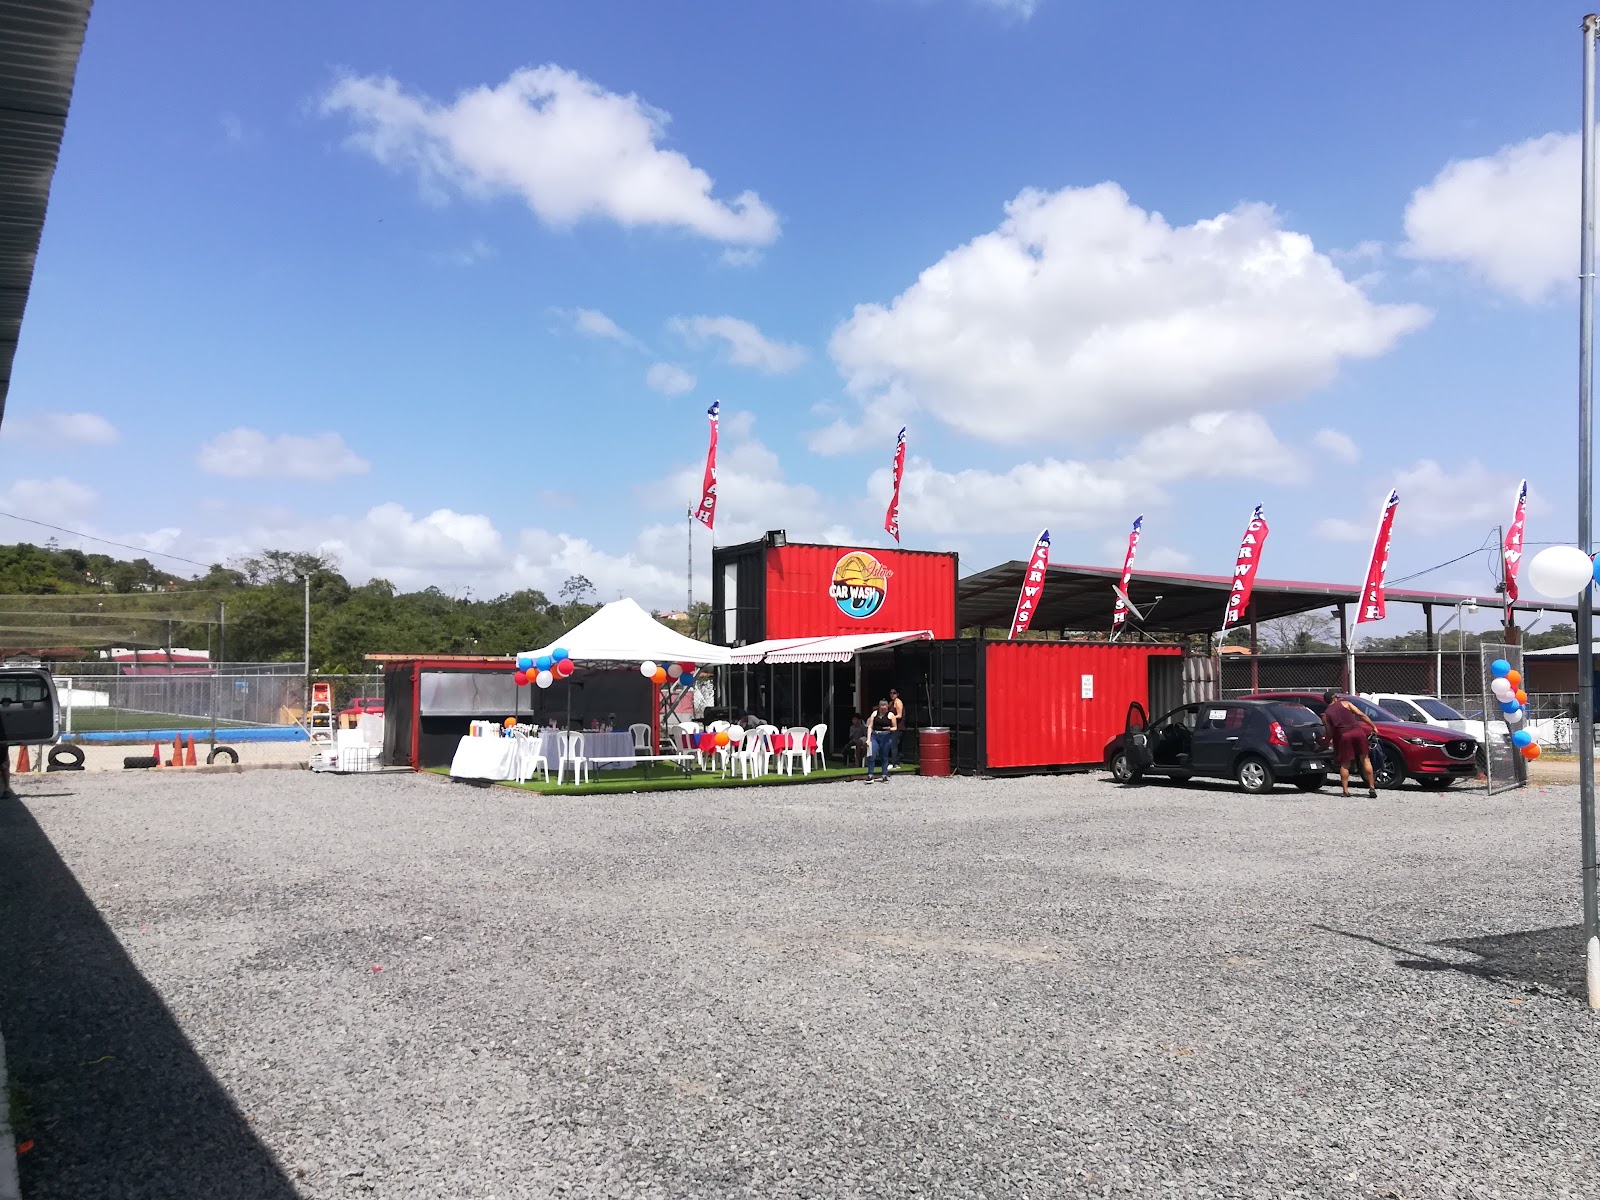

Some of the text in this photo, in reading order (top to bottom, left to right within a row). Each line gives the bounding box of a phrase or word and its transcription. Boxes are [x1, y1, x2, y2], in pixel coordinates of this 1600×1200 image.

[1238, 521, 1262, 558] CAR
[1029, 548, 1046, 582] CAR
[829, 585, 876, 600] CAR WASH
[1227, 564, 1252, 622] WASH
